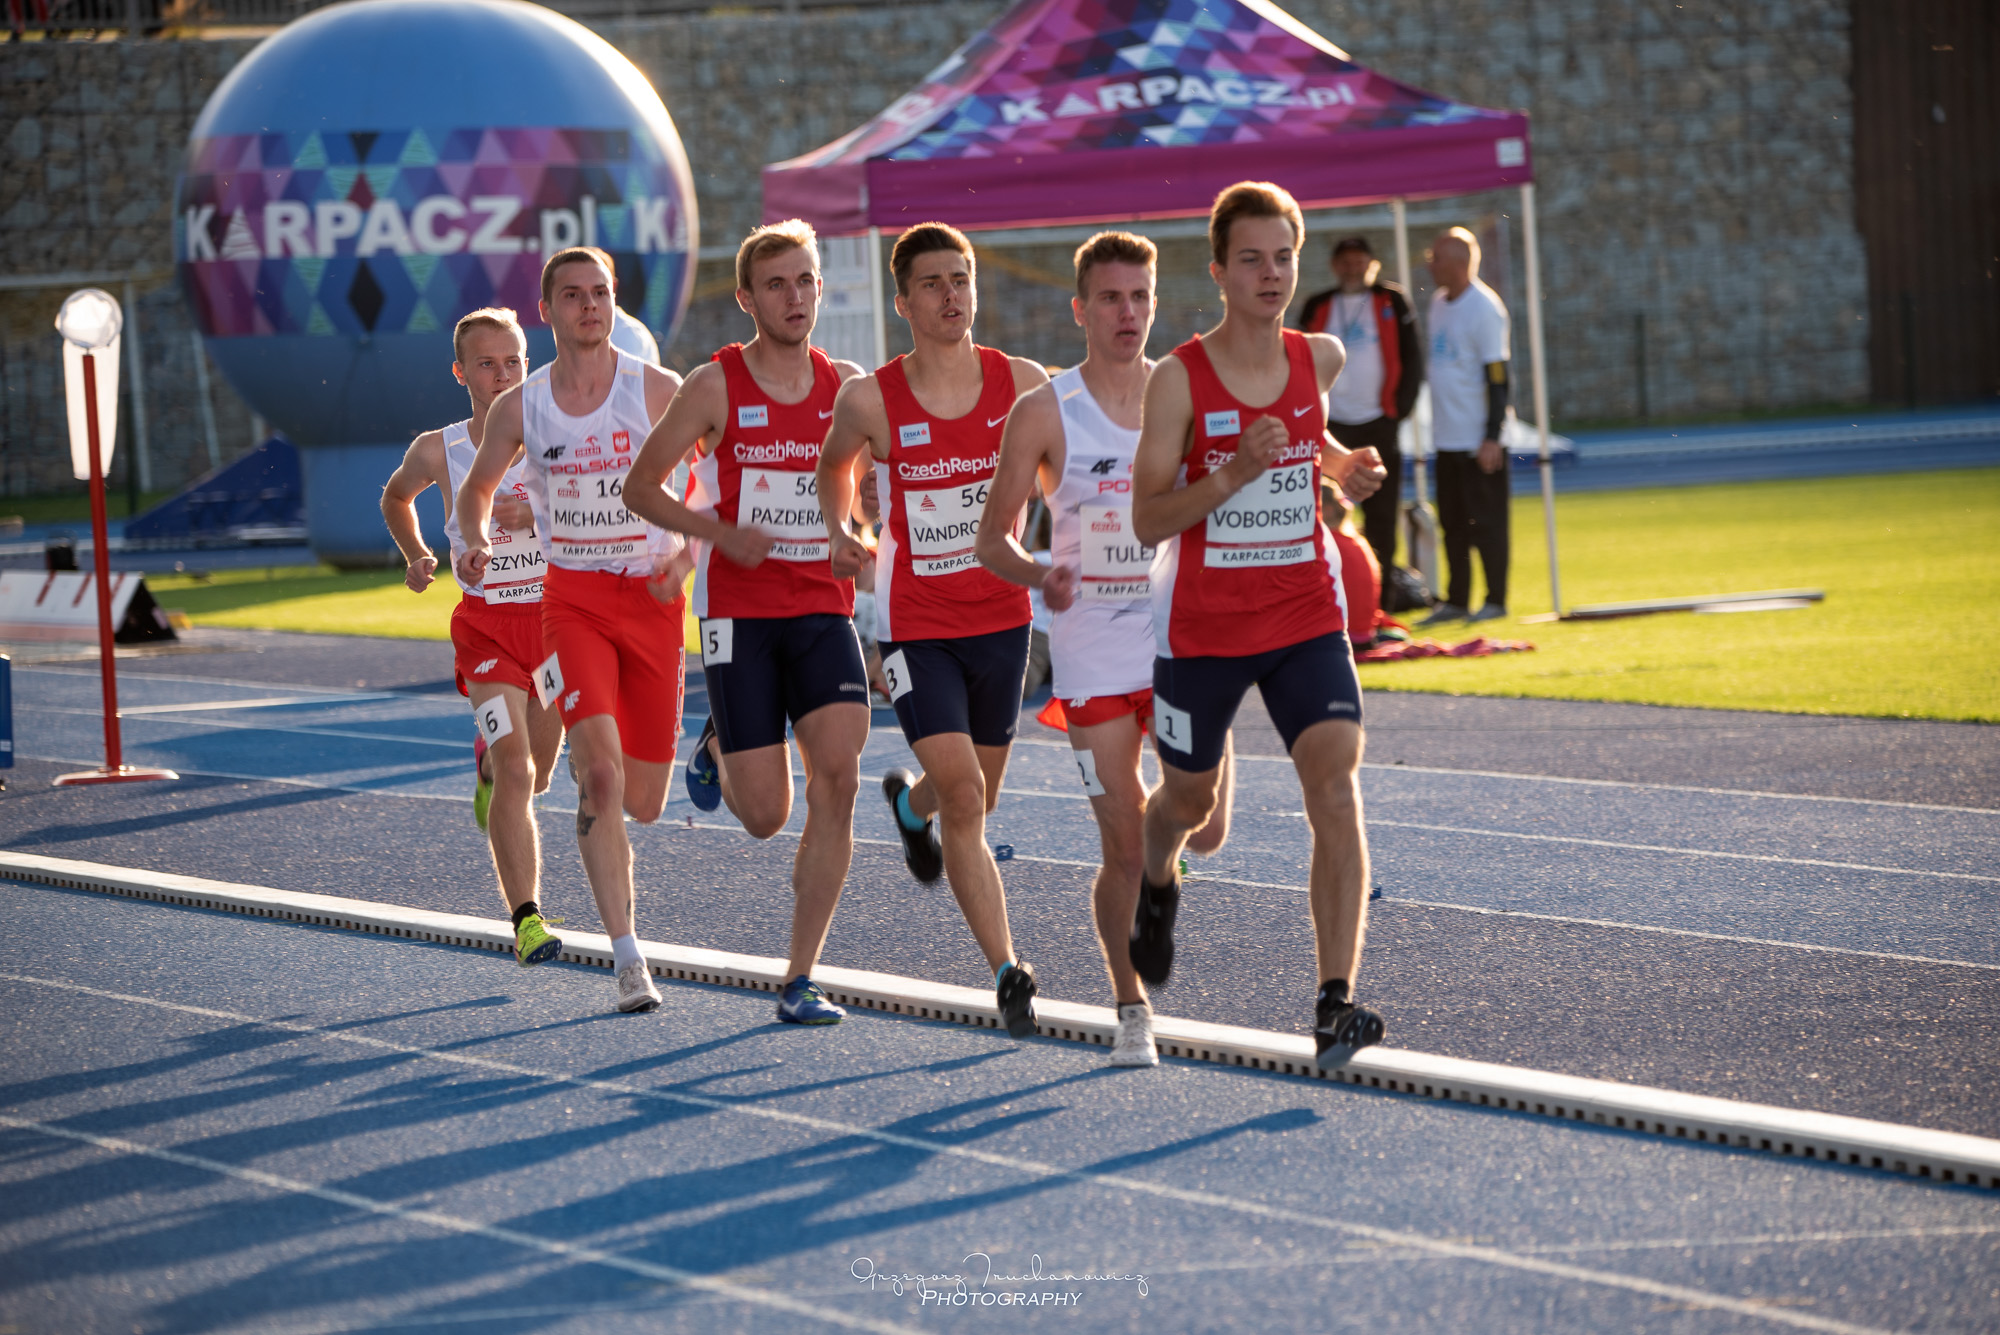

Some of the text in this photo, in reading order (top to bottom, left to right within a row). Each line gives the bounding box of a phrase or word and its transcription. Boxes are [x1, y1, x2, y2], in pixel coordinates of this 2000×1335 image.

[550, 456, 632, 476] POLSKA
[1270, 467, 1308, 494] 563
[962, 484, 988, 508] 56
[1213, 504, 1313, 528] VOBORSKY
[562, 543, 634, 556] KARPACZ 2020
[801, 545, 820, 556] 2020
[1222, 547, 1303, 562] KARPACZ 2020
[928, 554, 978, 571] KARPACZ
[498, 584, 544, 599] KARPACZ
[1097, 583, 1151, 596] KARPACZ
[708, 630, 719, 654] 5
[544, 669, 555, 691] 4
[886, 668, 898, 693] 3
[485, 710, 498, 734] 6
[1165, 716, 1177, 740] 1
